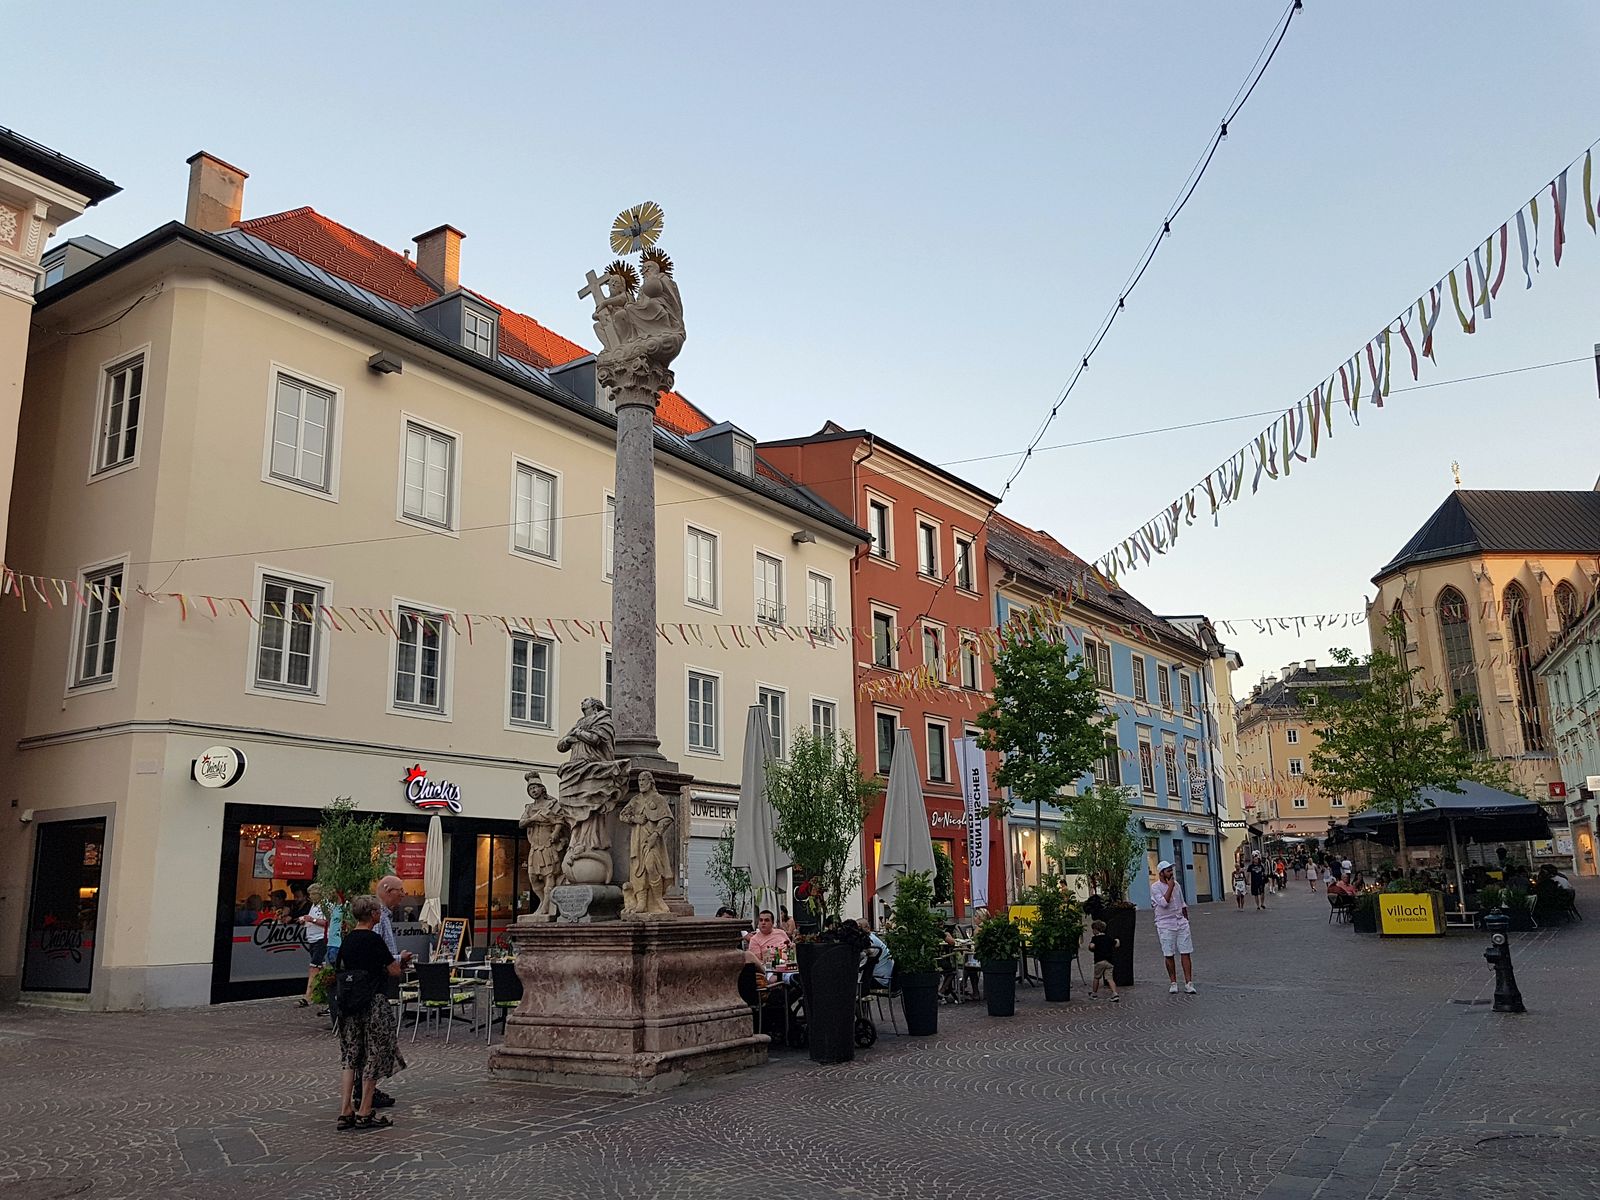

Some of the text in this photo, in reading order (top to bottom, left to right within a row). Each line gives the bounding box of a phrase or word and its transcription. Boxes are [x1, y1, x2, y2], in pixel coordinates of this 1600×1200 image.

[406, 775, 463, 813] Chickis
[690, 803, 732, 819] JUWELIER
[1386, 904, 1427, 917] villach
[253, 917, 310, 953] Chicki
